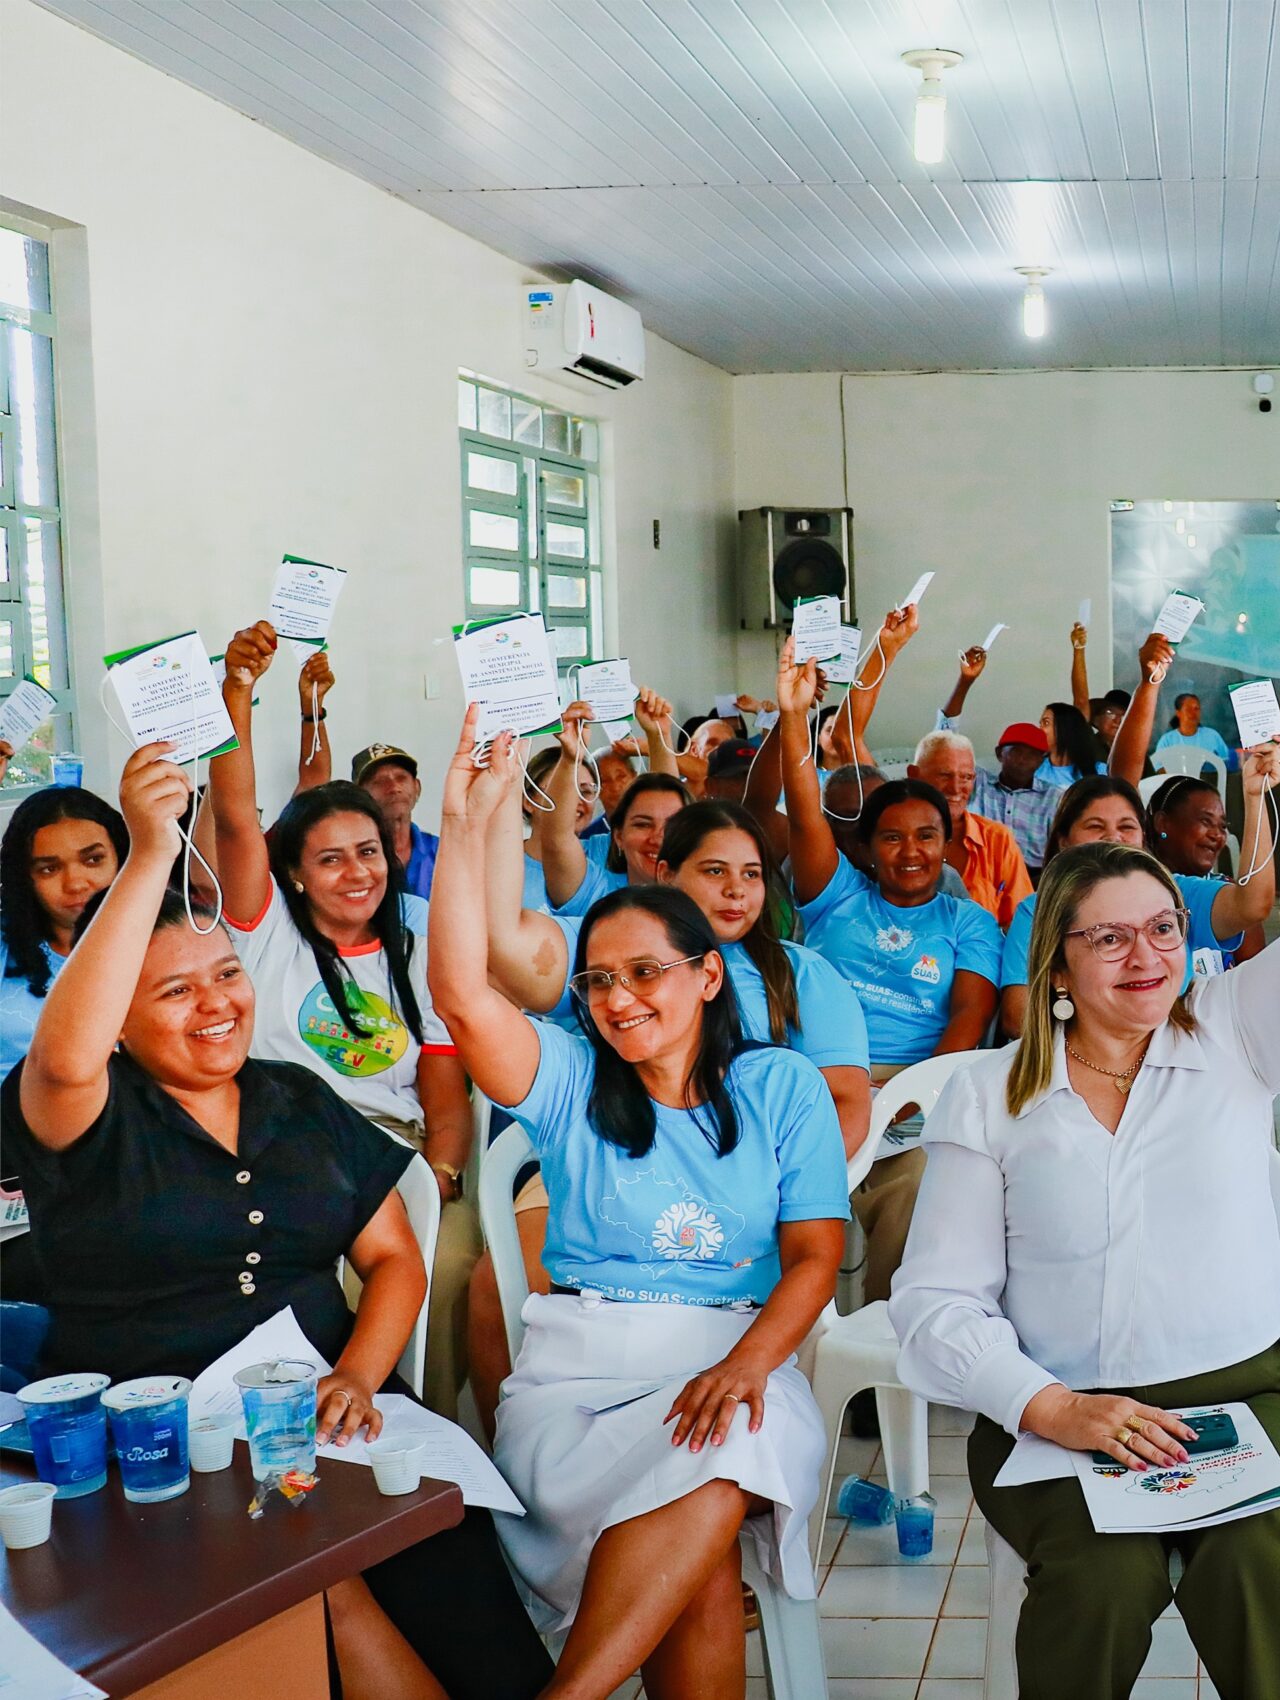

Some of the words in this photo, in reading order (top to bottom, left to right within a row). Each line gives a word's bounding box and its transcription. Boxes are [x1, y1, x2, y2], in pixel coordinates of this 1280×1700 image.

[148, 672, 191, 690] CONFERÊNCI
[137, 727, 159, 736] NOME:
[914, 968, 938, 980] SUAS
[865, 983, 894, 996] SUAS:
[681, 1226, 695, 1238] 20
[617, 1286, 636, 1299] do
[638, 1290, 685, 1304] SUAS:
[153, 1432, 172, 1441] 200ml
[127, 1446, 169, 1461] Rosa
